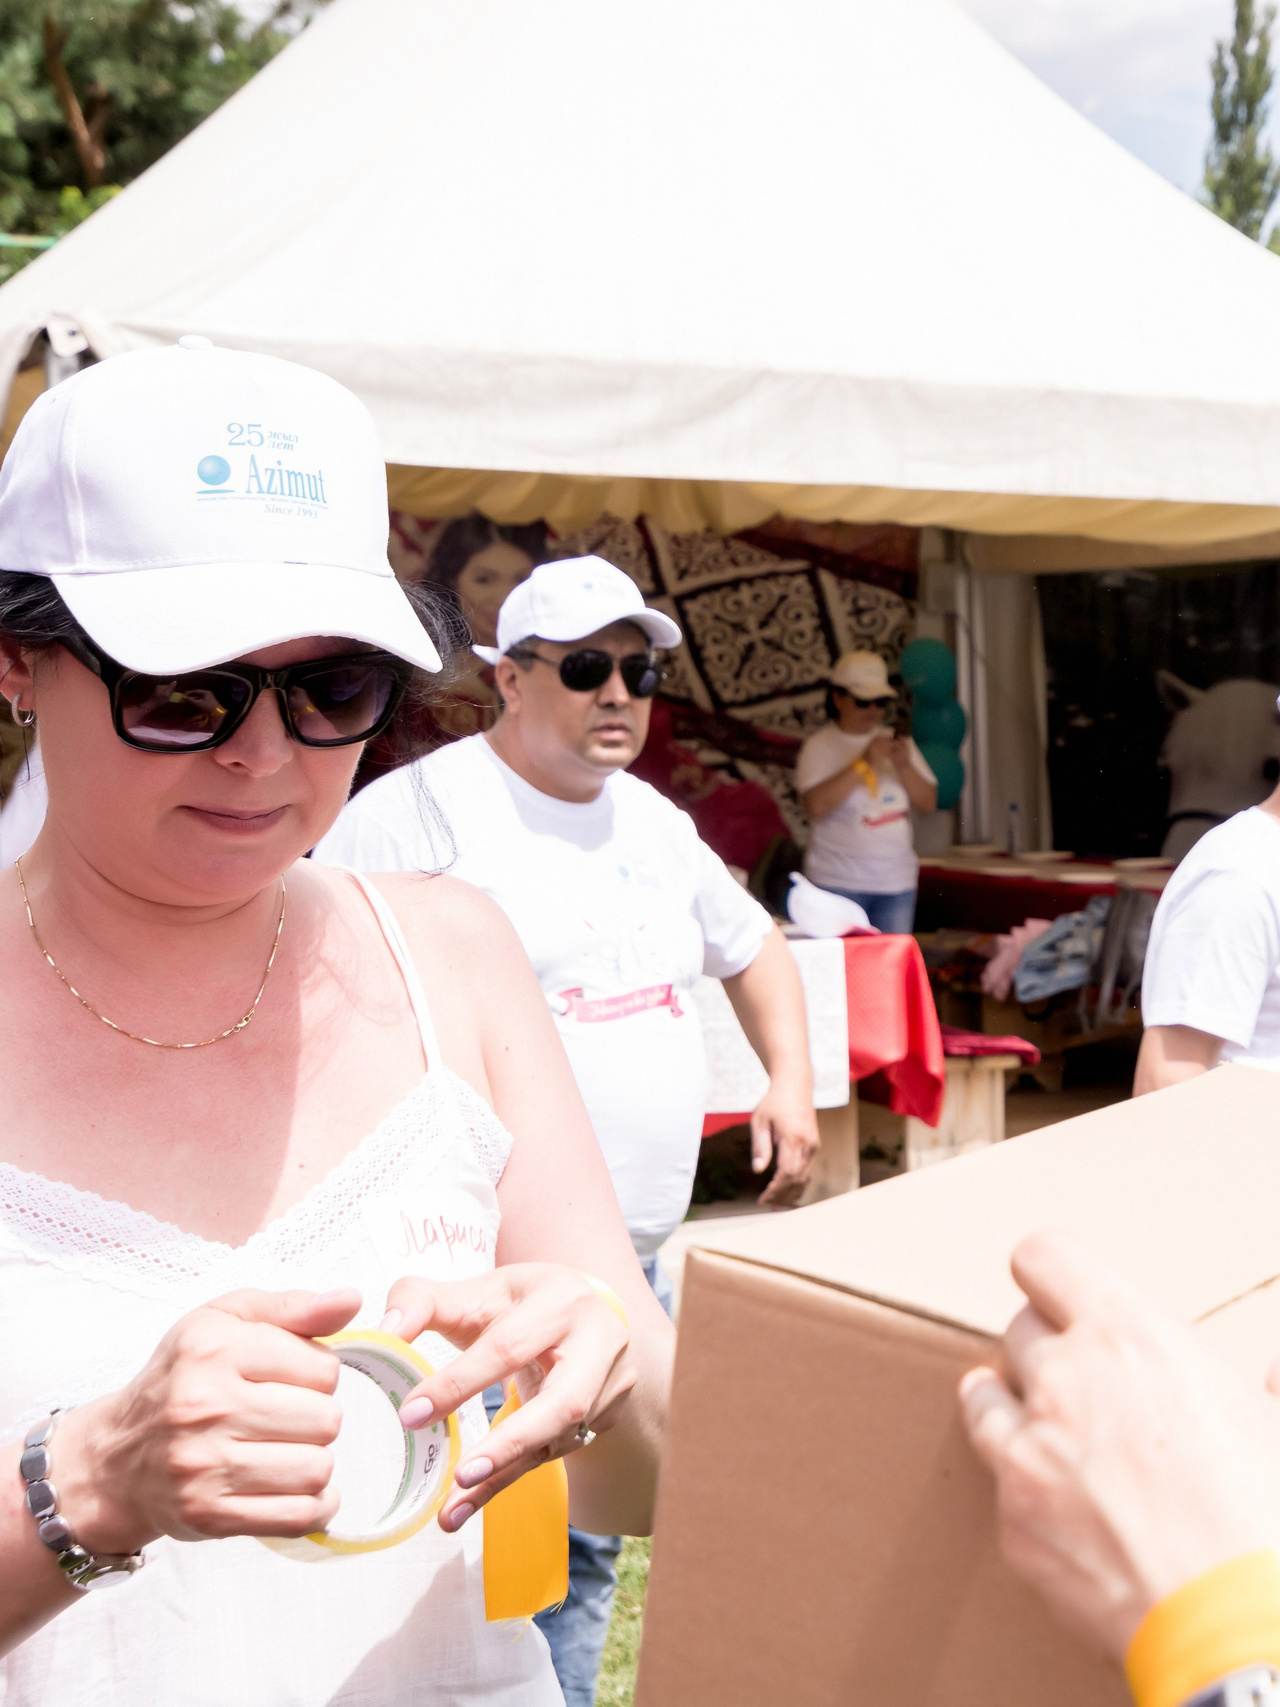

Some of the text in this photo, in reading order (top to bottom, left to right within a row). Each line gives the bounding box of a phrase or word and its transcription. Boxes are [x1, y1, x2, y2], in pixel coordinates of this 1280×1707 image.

[227, 422, 265, 447] 25
[245, 454, 327, 504] Azimut
[264, 504, 293, 516] Since
[297, 505, 318, 519] 1993
